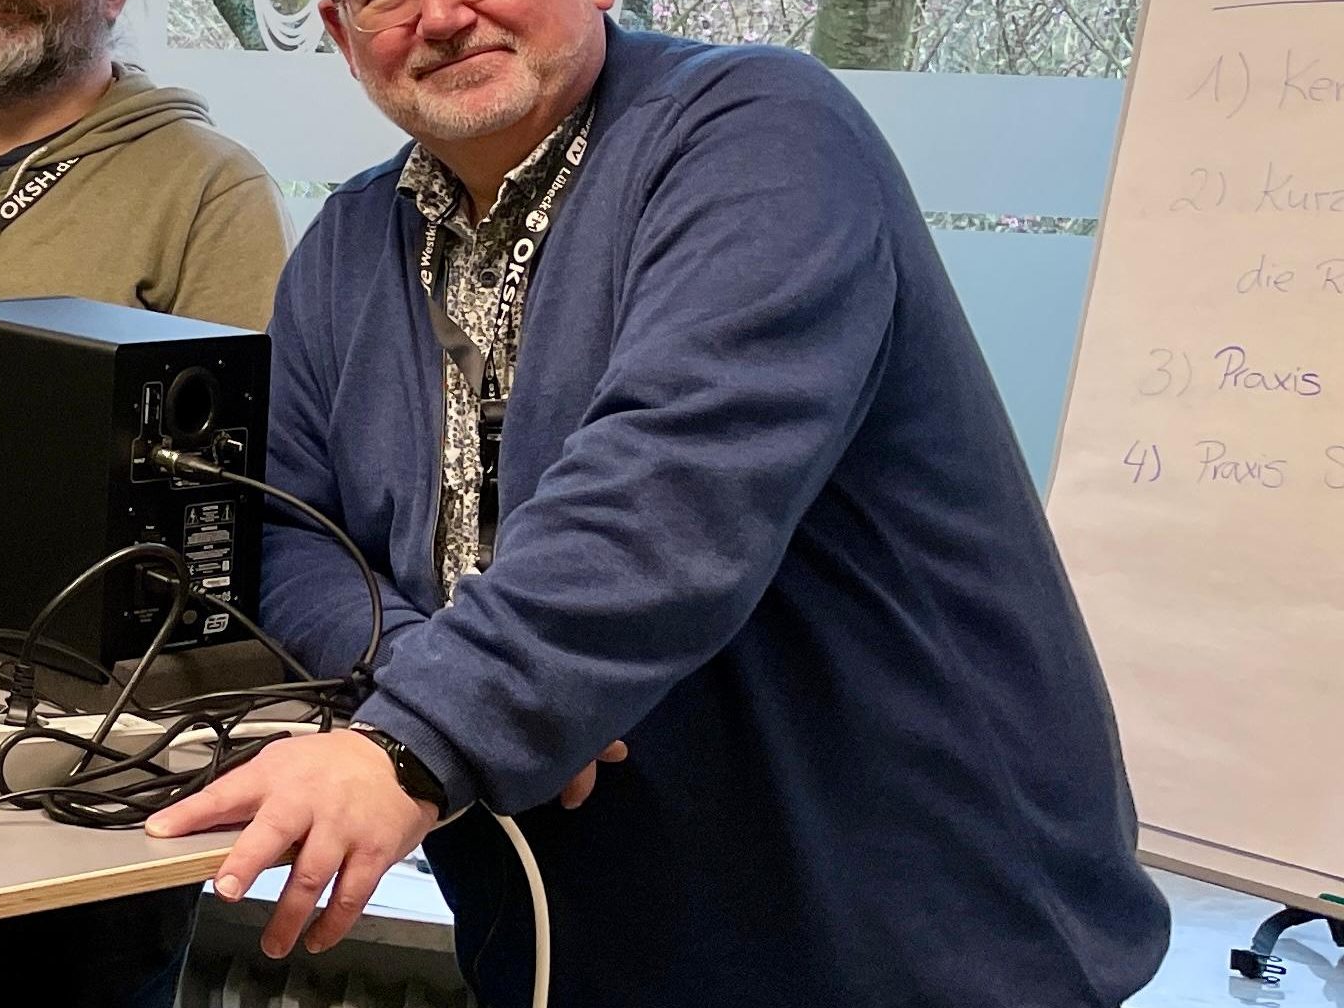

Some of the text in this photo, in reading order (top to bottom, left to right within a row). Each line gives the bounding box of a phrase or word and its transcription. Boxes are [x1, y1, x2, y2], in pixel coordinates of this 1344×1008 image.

[570, 139, 587, 163] TV
[538, 167, 571, 211] Lübeck
[527, 211, 547, 232] FM
[1236, 254, 1295, 294] die
[1214, 346, 1322, 396] Praxis
[1123, 440, 1162, 484] 4)
[1196, 440, 1288, 489] Praxis
